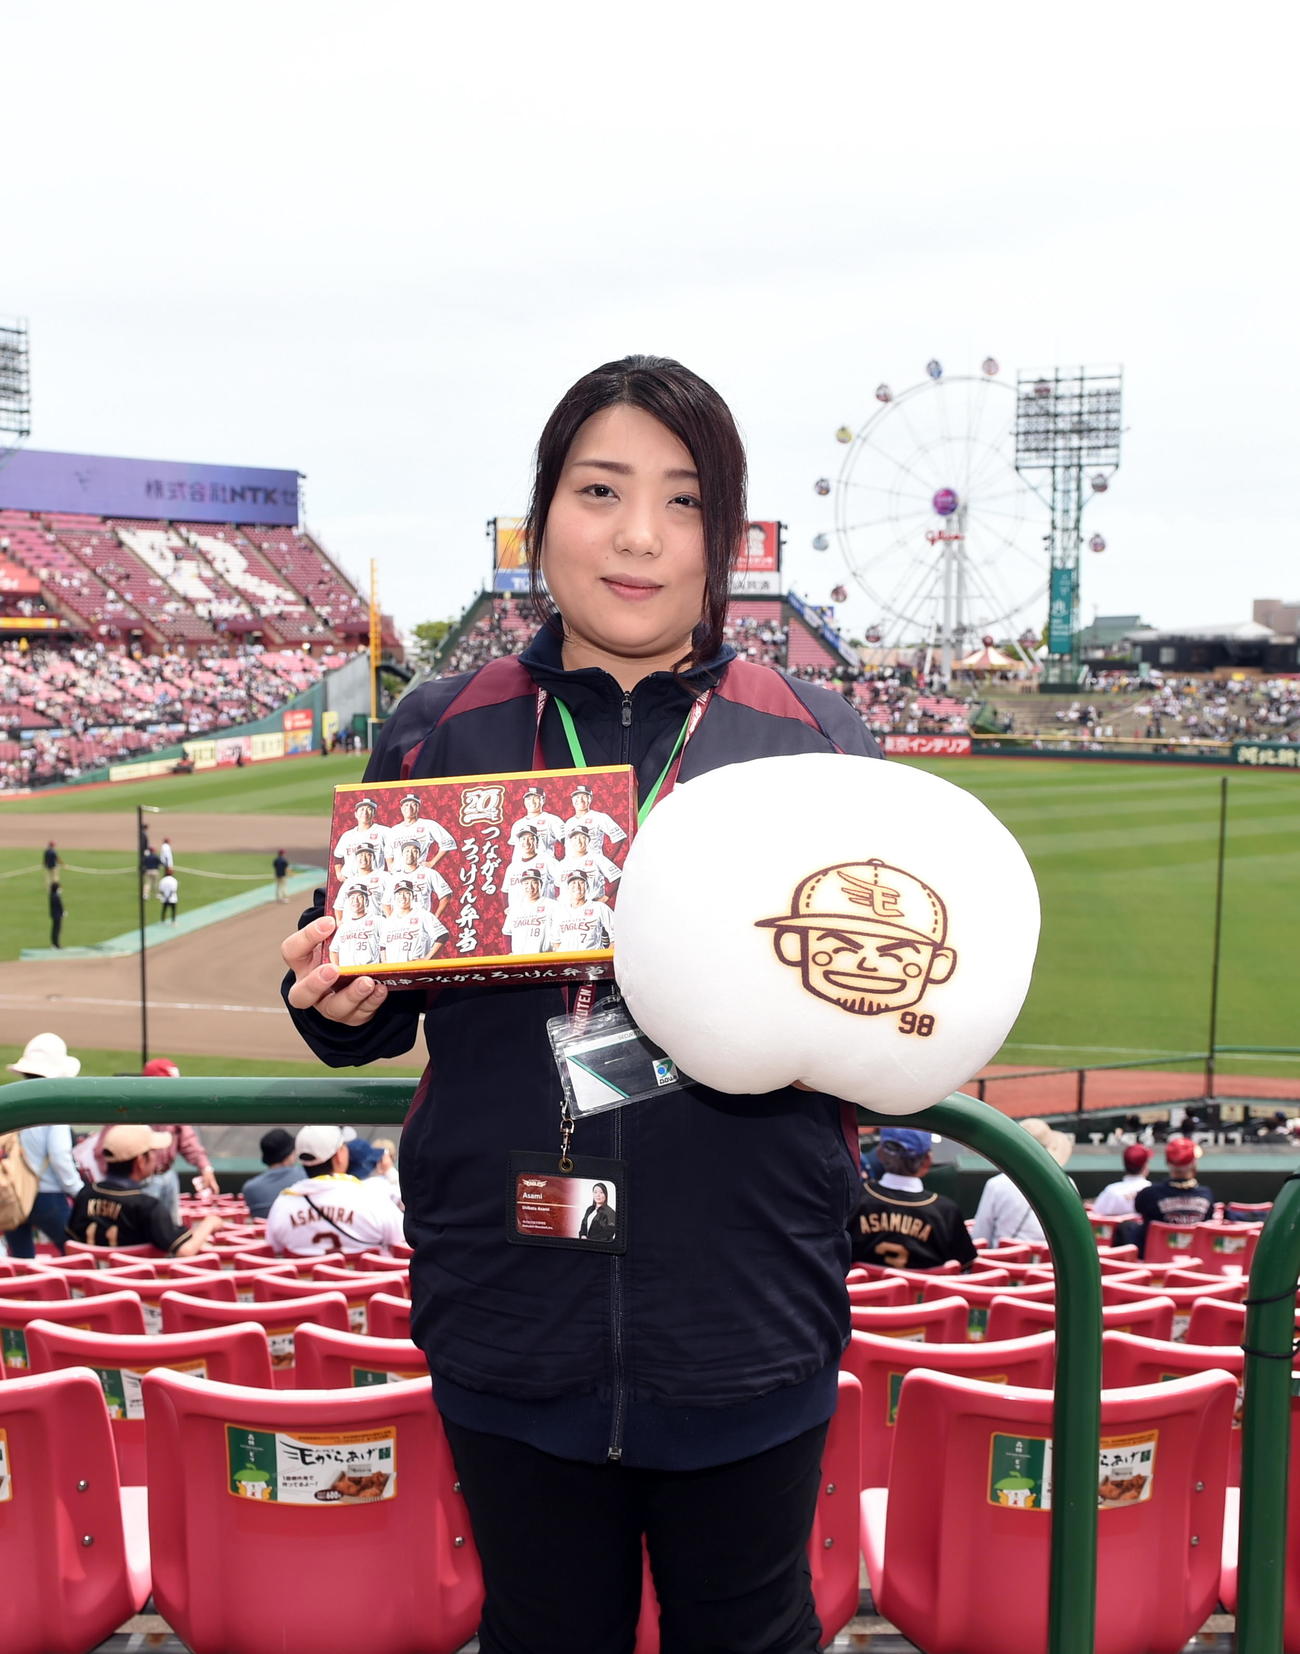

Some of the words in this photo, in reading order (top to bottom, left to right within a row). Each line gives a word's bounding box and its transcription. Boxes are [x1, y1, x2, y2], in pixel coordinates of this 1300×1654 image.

[480, 826, 502, 895] つながる
[456, 837, 480, 953] ろっけん弁当
[530, 928, 540, 937] 18
[580, 934, 587, 943] 7
[356, 942, 367, 951] 35
[402, 942, 413, 951] 21
[898, 1011, 935, 1037] 98
[522, 1192, 543, 1200] Asami
[289, 1208, 355, 1229] ASAMURA
[860, 1212, 932, 1242] ASAMURA
